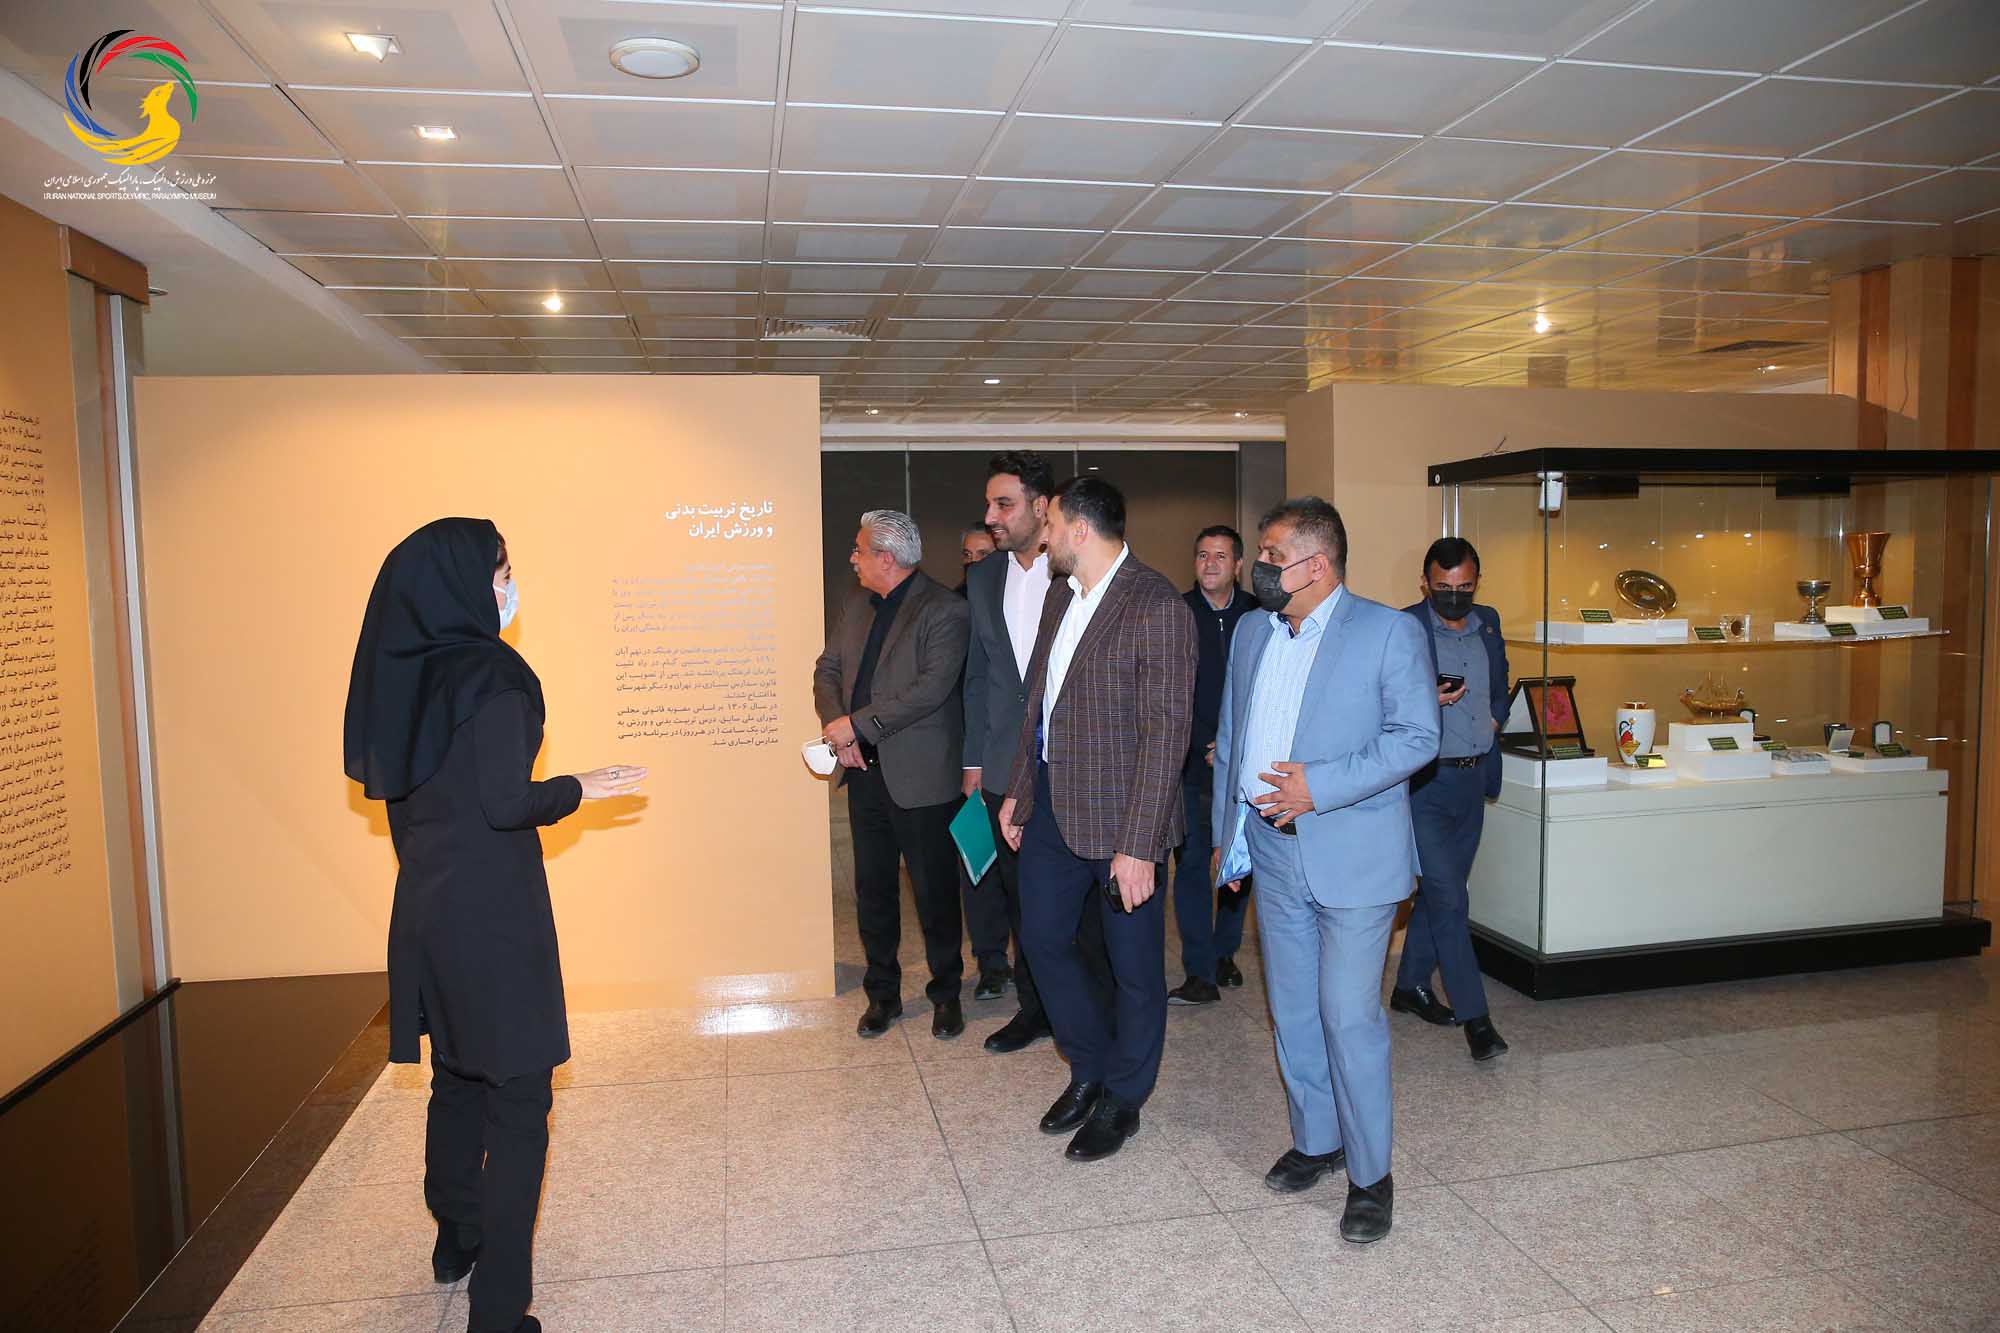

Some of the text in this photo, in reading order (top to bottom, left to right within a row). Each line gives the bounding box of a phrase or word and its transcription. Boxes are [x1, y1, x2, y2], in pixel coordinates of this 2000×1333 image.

[664, 500, 774, 522] تاریخ تربیت بدنی
[688, 519, 774, 540] و ورزش ایران
